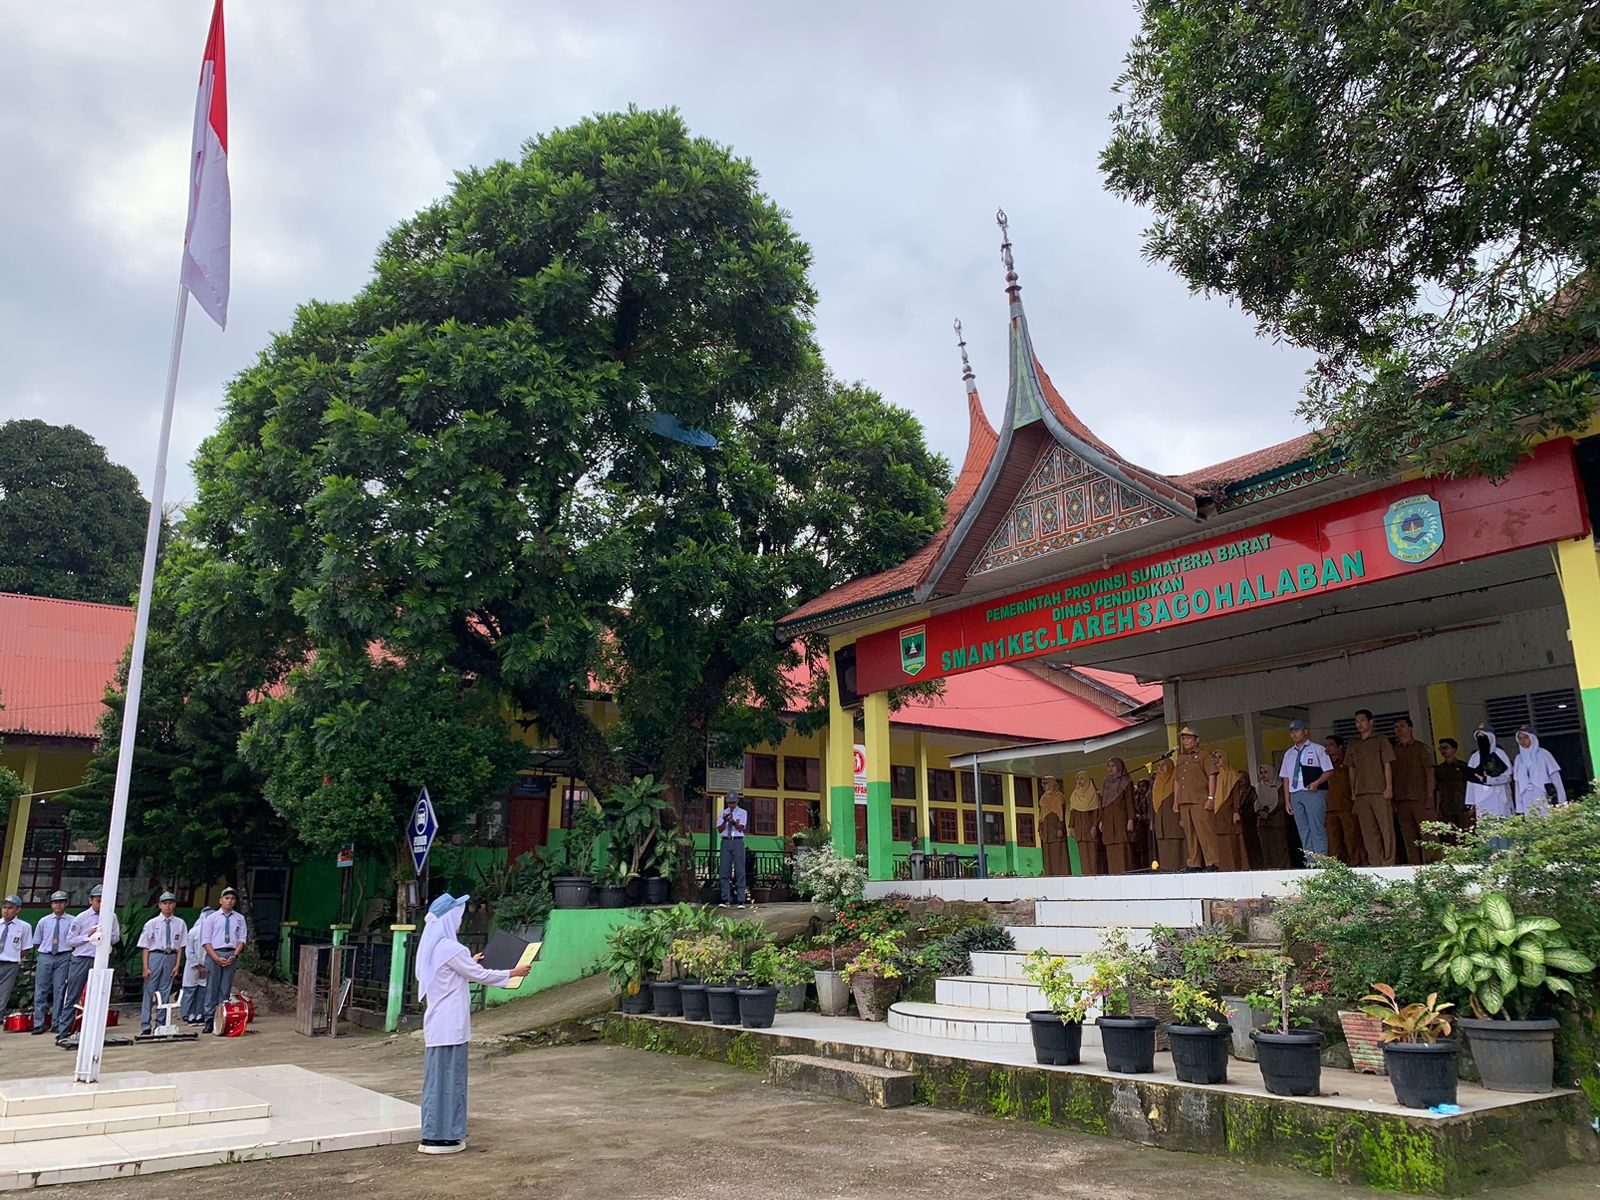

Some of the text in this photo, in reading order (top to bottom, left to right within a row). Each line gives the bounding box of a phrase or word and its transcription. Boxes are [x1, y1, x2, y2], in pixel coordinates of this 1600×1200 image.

[986, 534, 1272, 622] PEMERINTAH PROVINSI SUMATERA BARAT
[1052, 576, 1184, 622] DINAS PENDIDIKAN
[1138, 589, 1210, 627] SAGO
[1214, 550, 1365, 610] HALABAN
